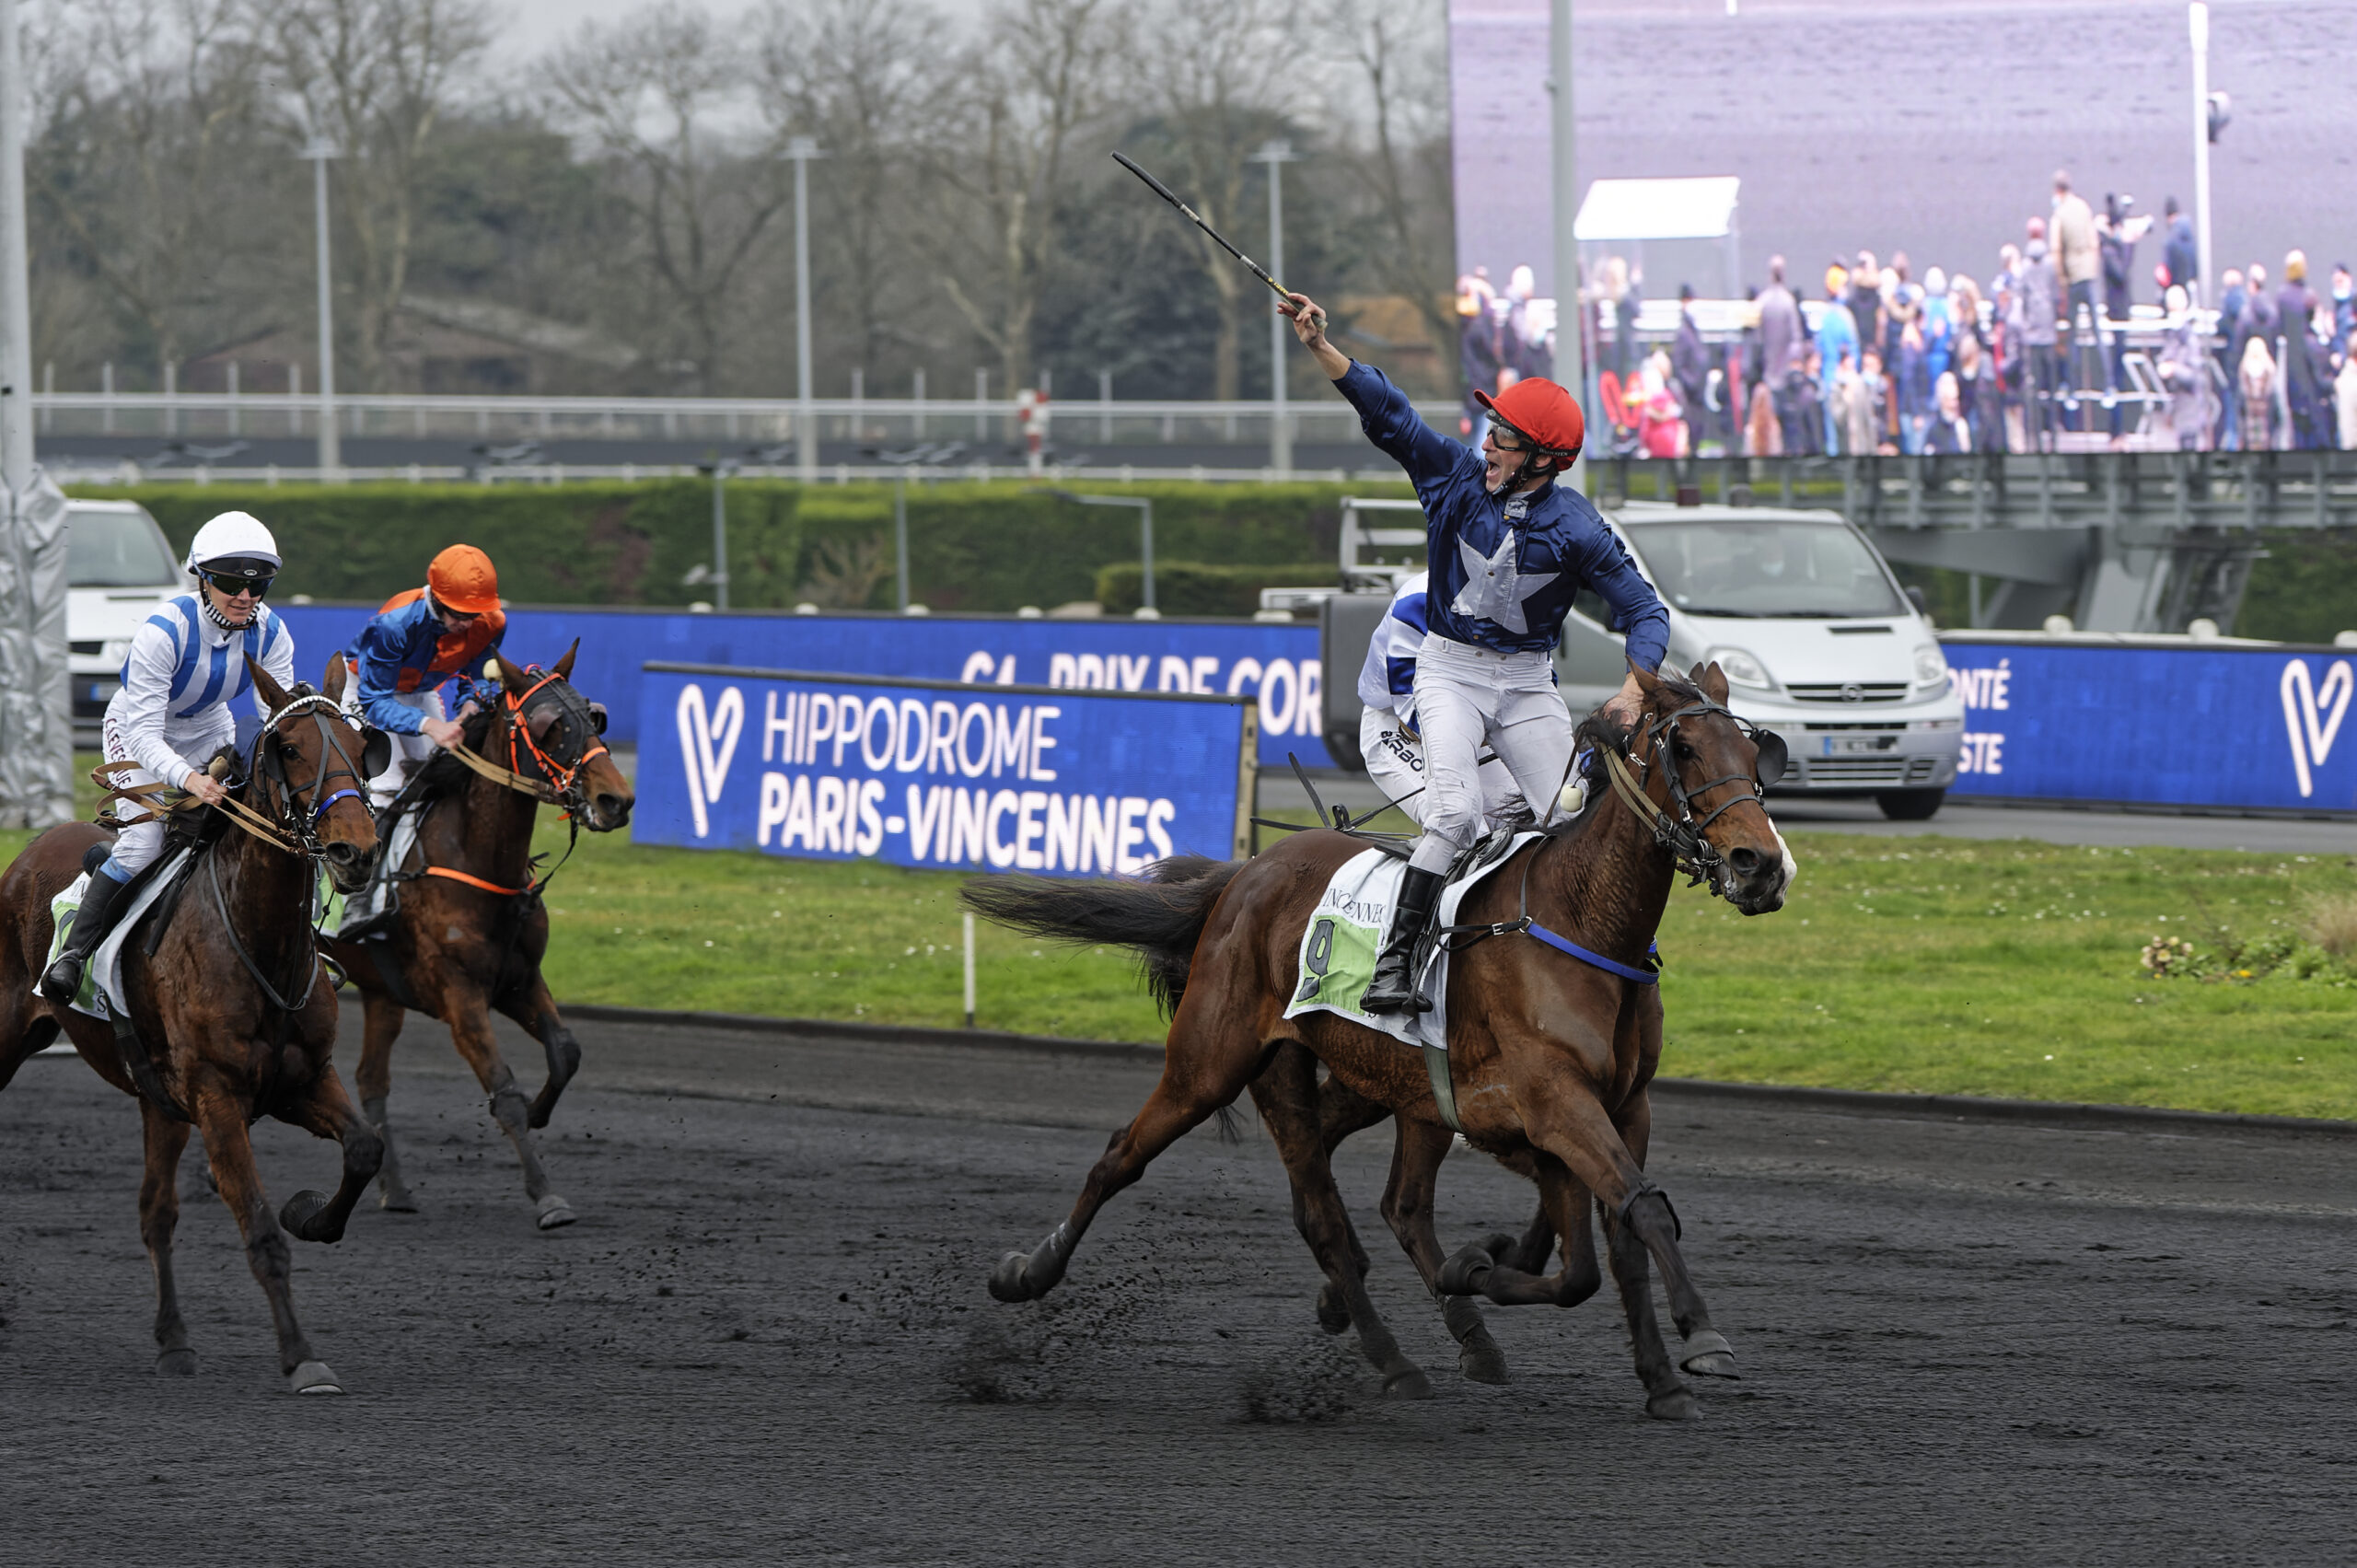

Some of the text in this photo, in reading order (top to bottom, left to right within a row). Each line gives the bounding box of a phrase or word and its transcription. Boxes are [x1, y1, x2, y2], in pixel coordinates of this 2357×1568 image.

[762, 691, 1062, 781] HIPPODROME
[757, 772, 1176, 876] PARIS-VINCENNES
[1295, 918, 1335, 1003] 9
